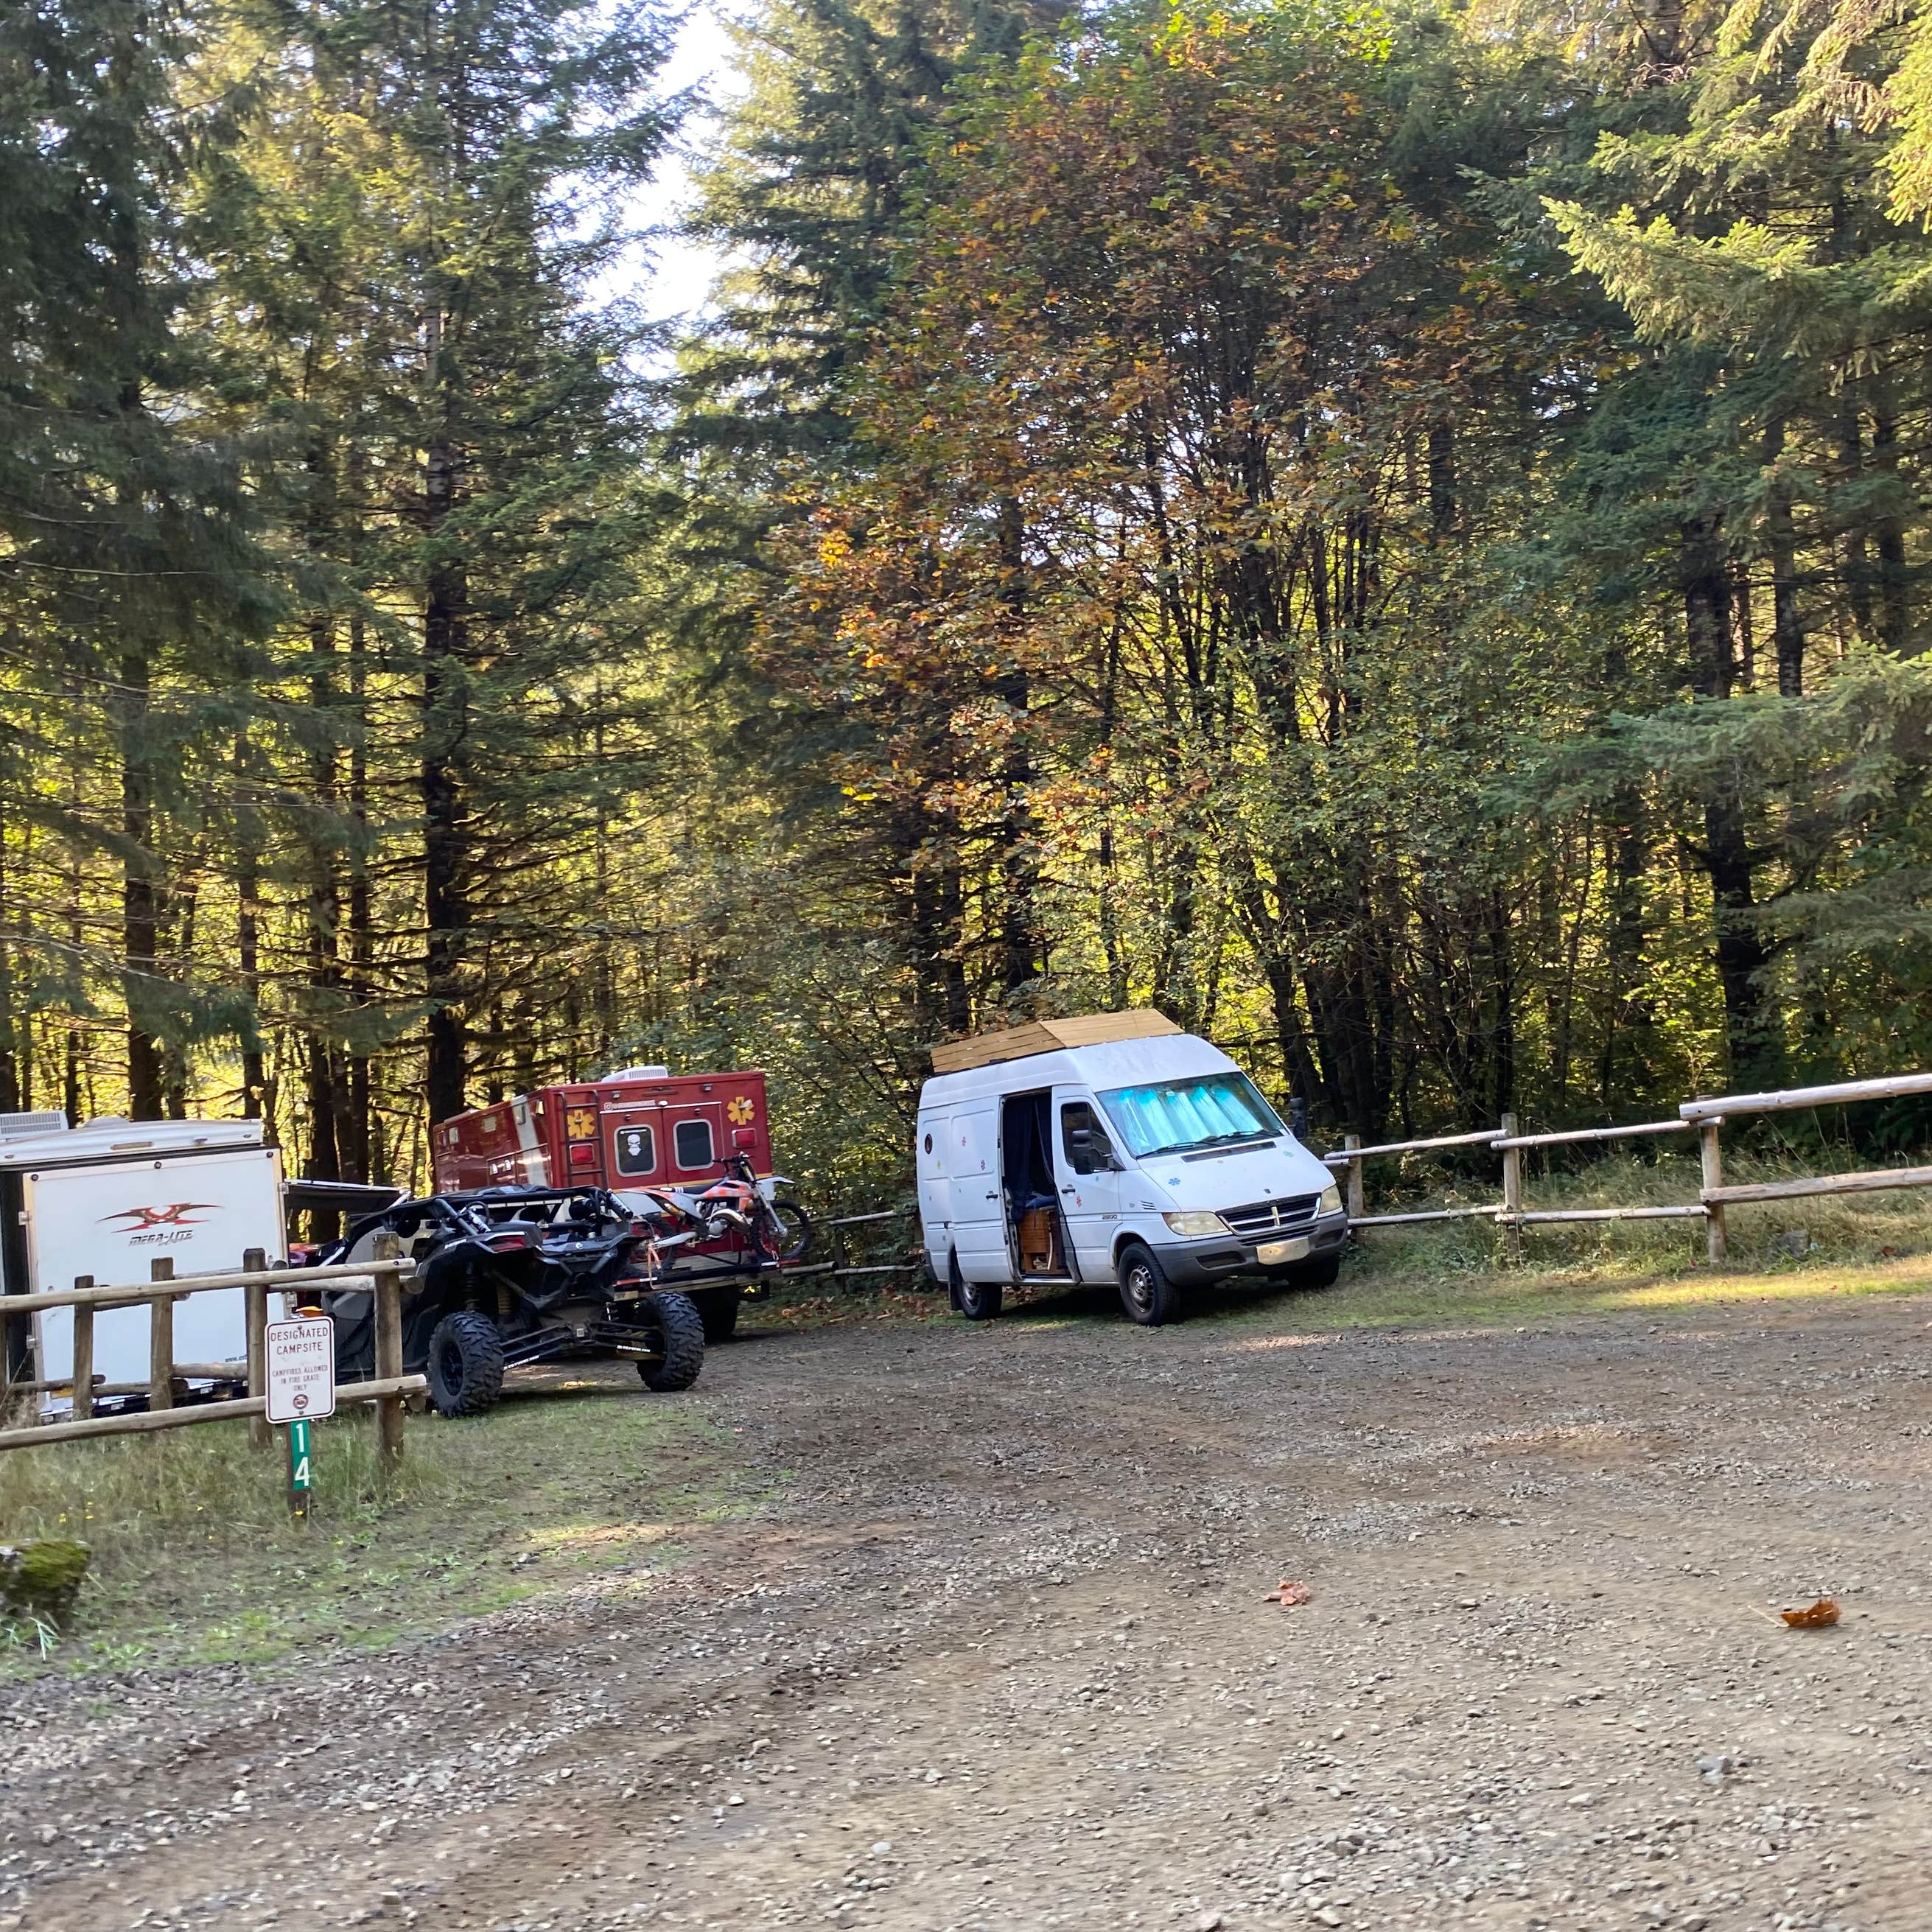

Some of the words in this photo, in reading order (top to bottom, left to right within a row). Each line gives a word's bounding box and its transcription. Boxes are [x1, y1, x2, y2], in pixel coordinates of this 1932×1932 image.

[270, 1327, 329, 1342] DESIGNATED
[276, 1342, 323, 1355] CAMPSITE
[272, 1368, 301, 1377] CAMPFIRES
[304, 1365, 329, 1373] ALLOWED
[295, 1423, 309, 1487] 14
